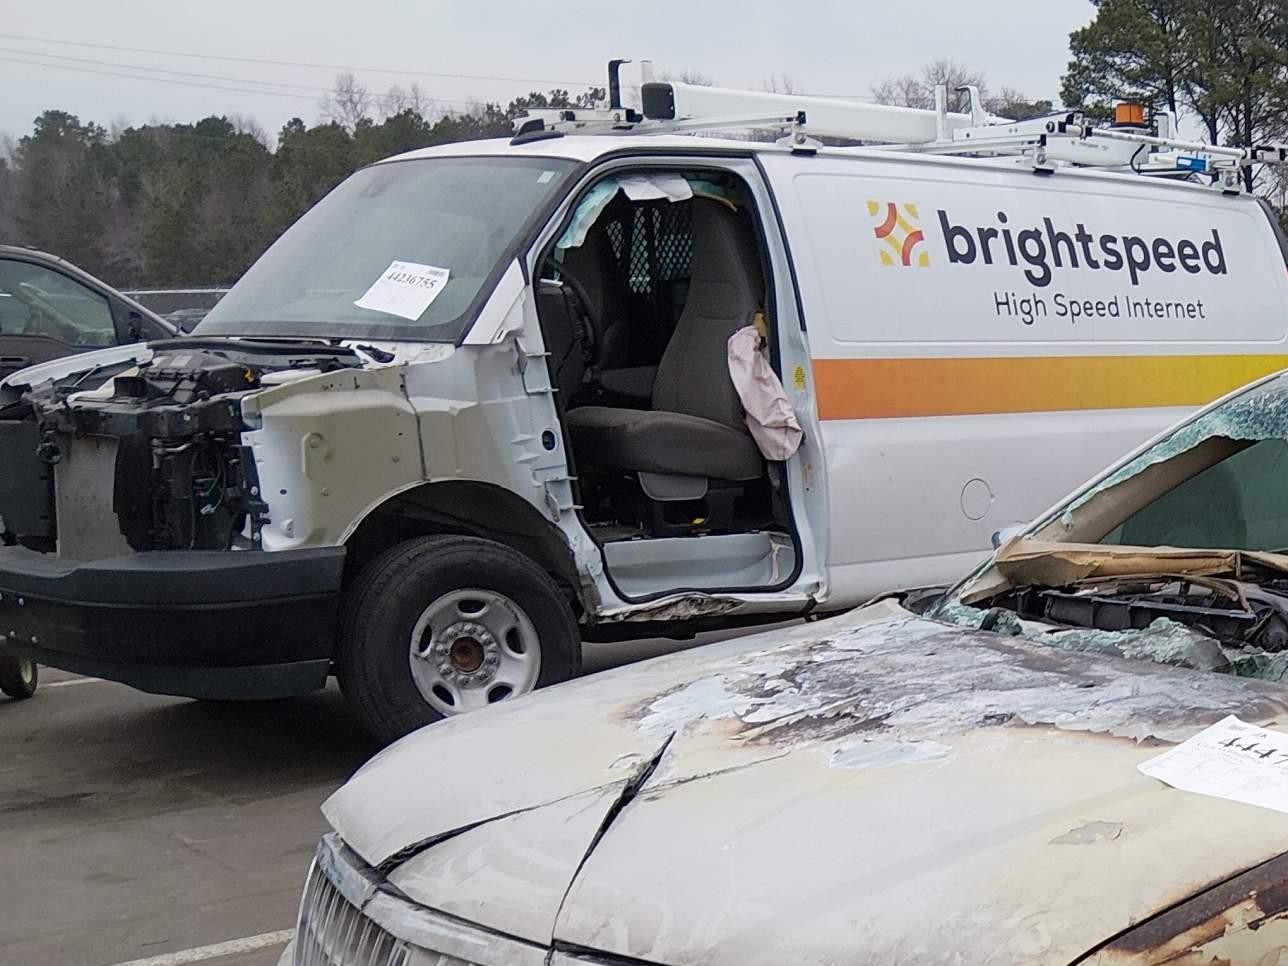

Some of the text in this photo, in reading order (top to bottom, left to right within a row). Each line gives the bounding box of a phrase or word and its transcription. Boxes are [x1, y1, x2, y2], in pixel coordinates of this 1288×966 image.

[937, 209, 1228, 287] brightspeed
[993, 292, 1206, 325] High Speed Internet
